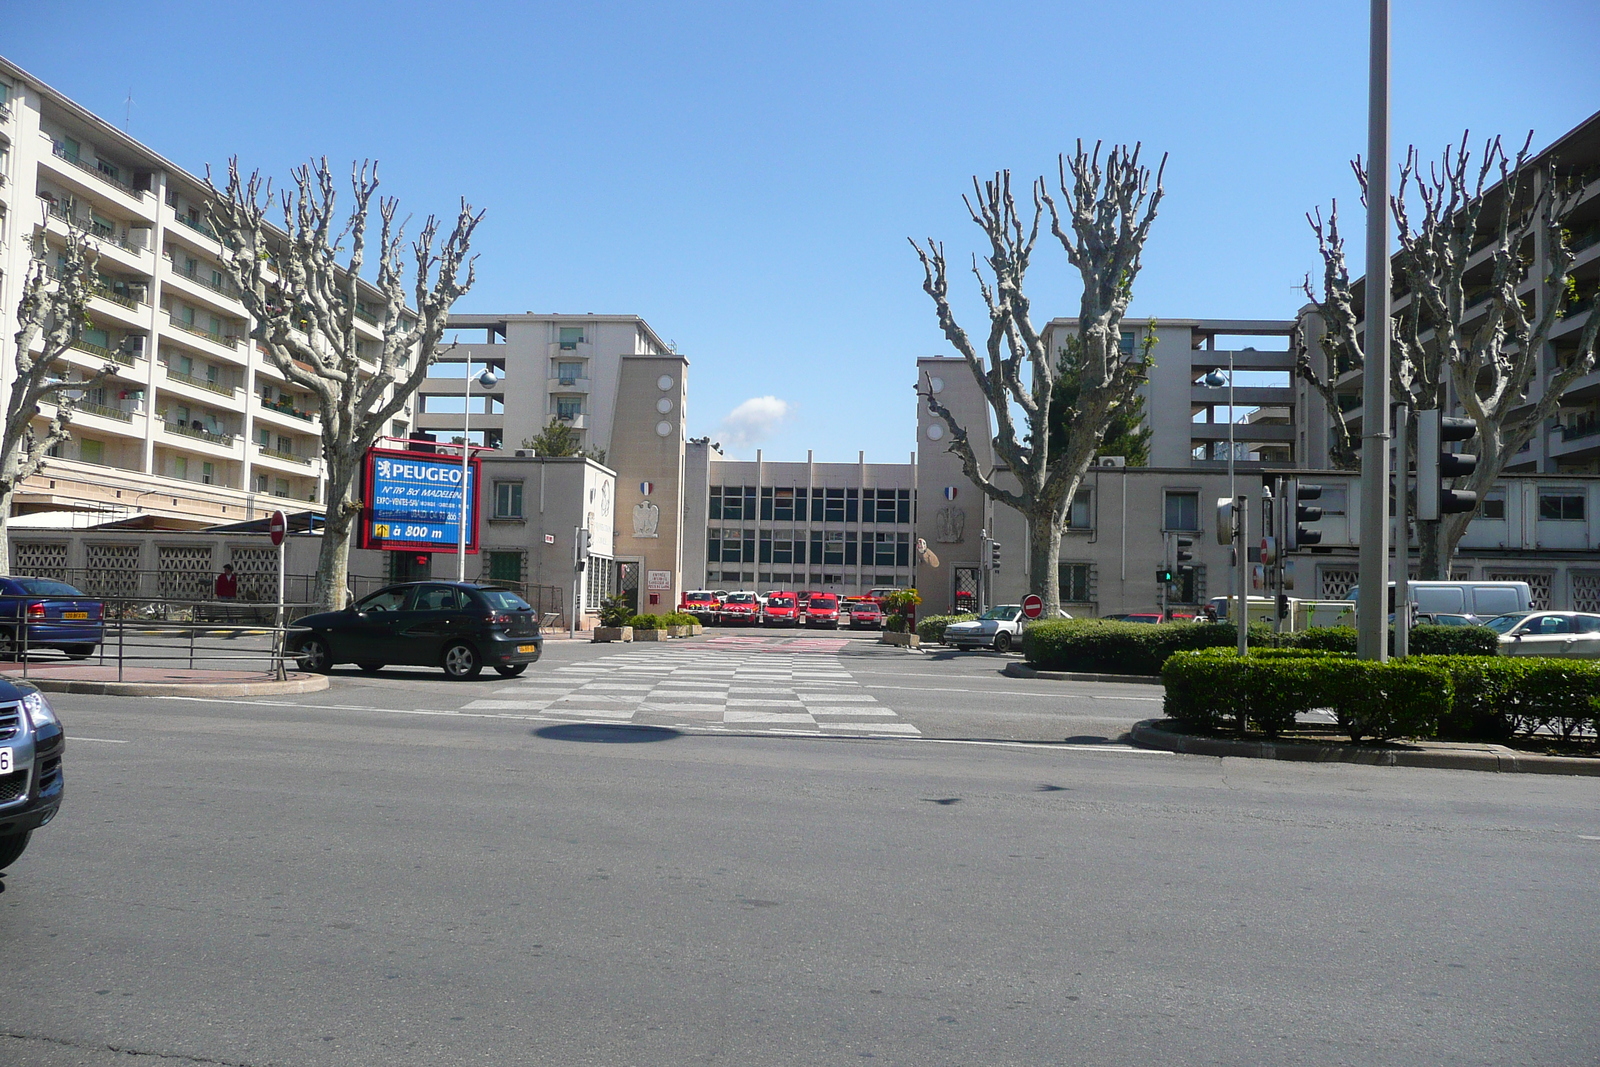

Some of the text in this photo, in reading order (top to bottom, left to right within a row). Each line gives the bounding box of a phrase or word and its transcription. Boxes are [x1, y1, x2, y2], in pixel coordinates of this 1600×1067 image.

[421, 489, 462, 499] MADELEIN
[393, 524, 442, 538] à 800 m
[1, 752, 8, 770] 6
